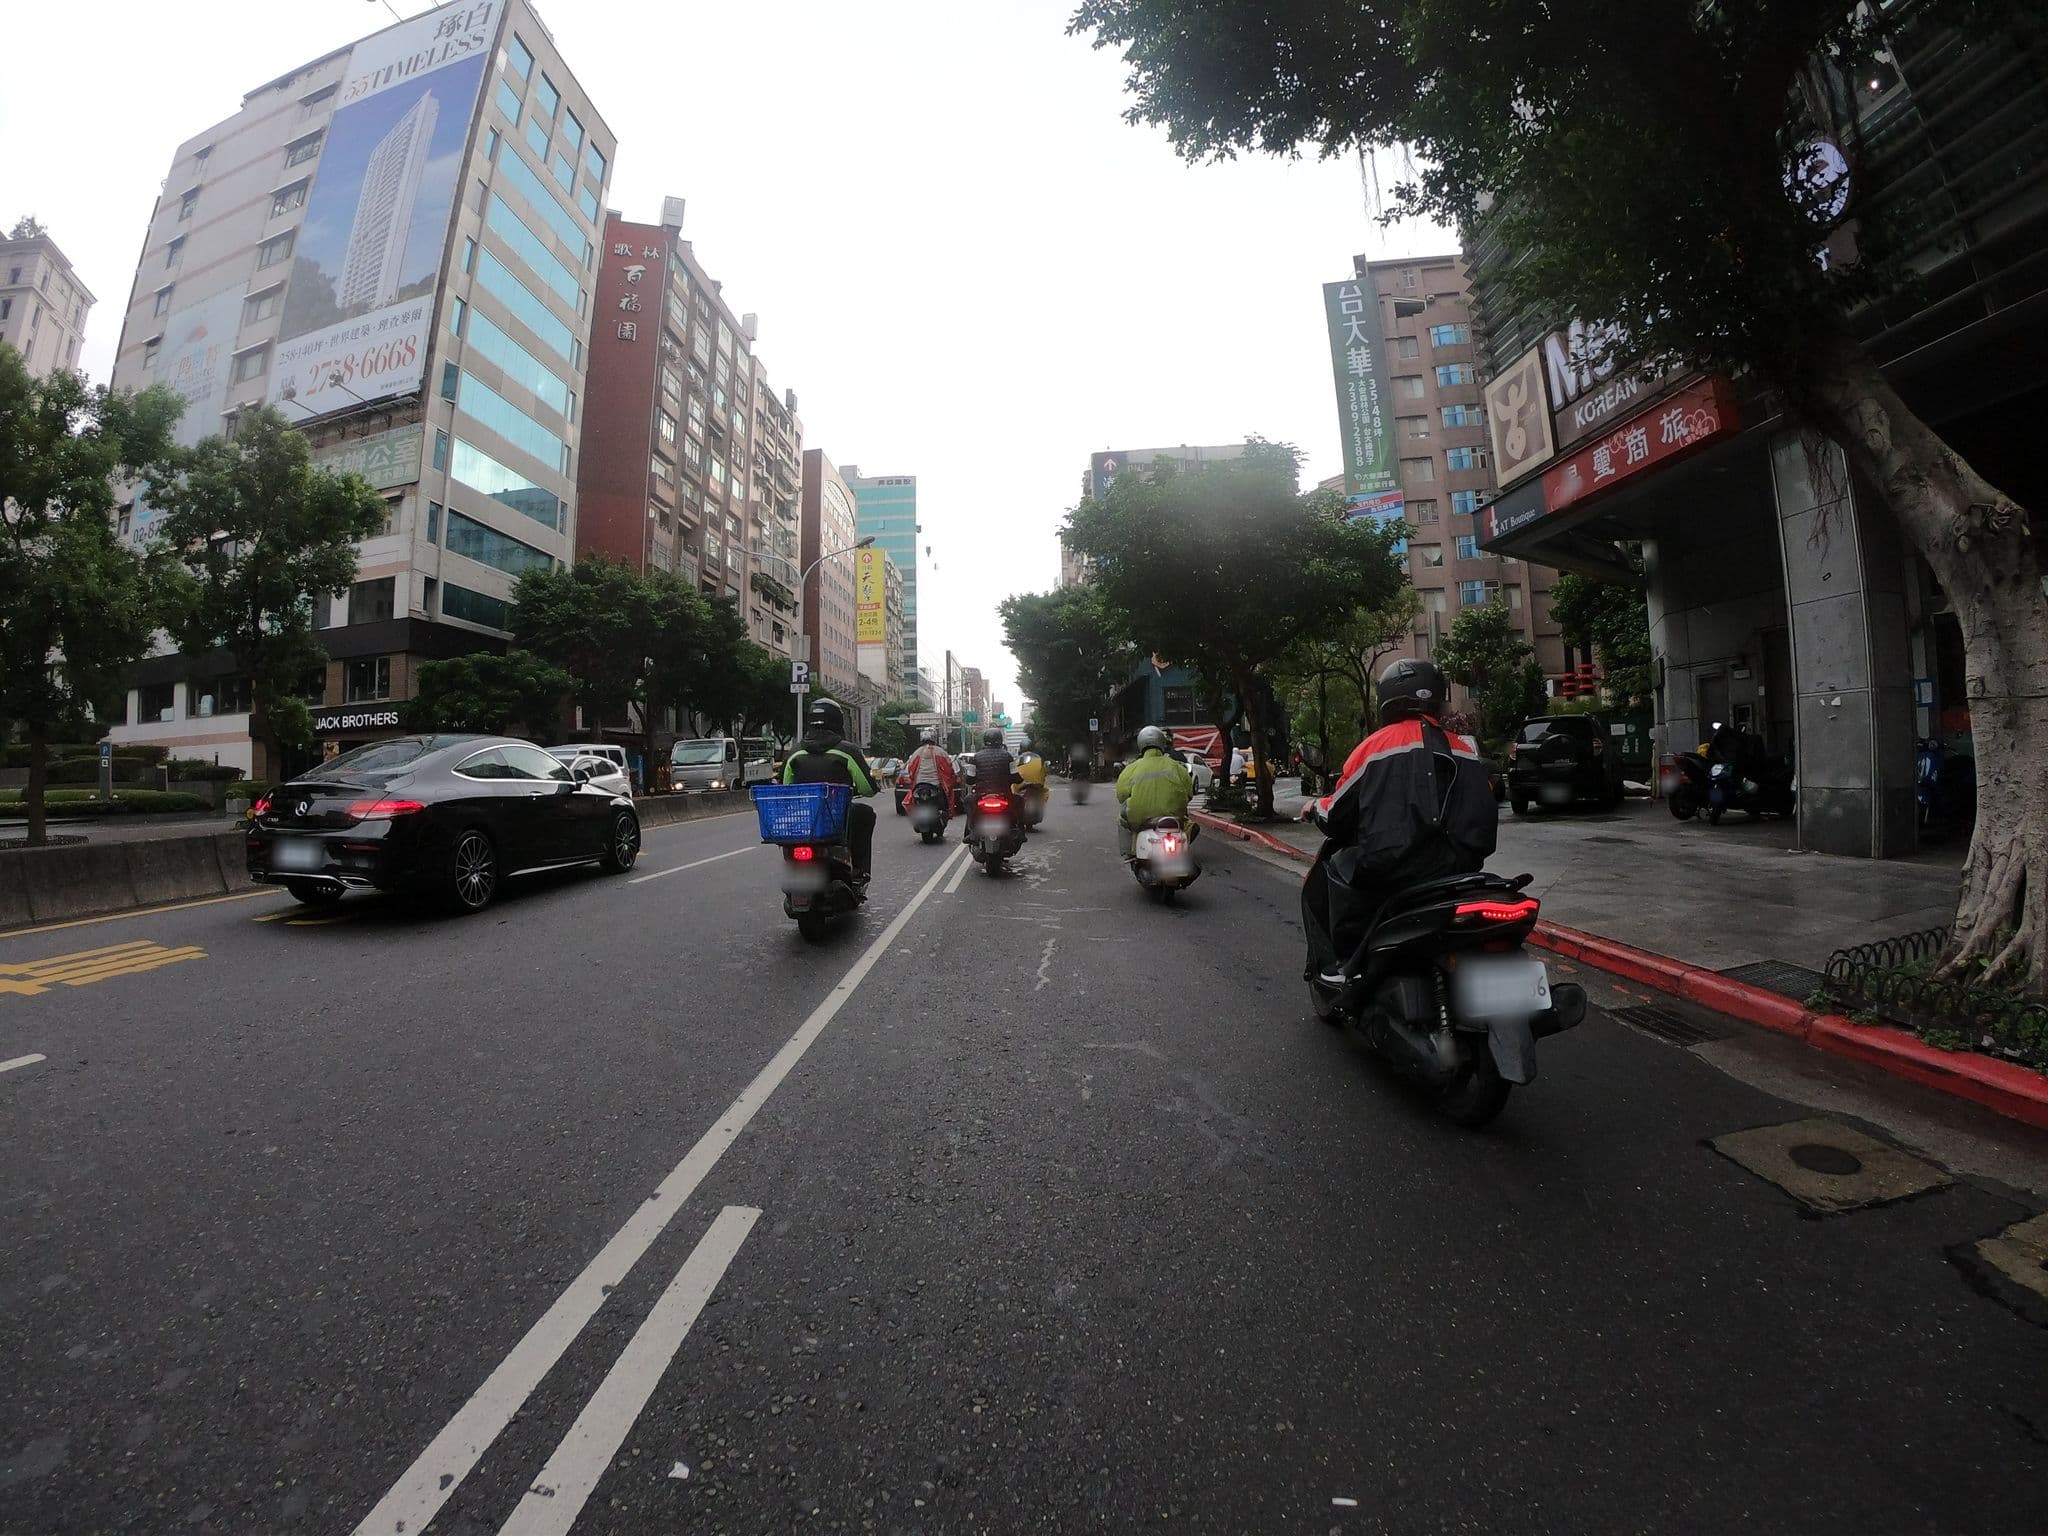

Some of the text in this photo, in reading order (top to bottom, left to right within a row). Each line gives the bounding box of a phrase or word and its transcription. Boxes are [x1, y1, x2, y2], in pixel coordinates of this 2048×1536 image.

[614, 243, 660, 259] 歌林
[617, 264, 647, 342] 百福園
[1338, 284, 1373, 377] 台大華
[1574, 376, 1639, 429] KOREAN
[315, 711, 399, 731] JACK BROTHERS
